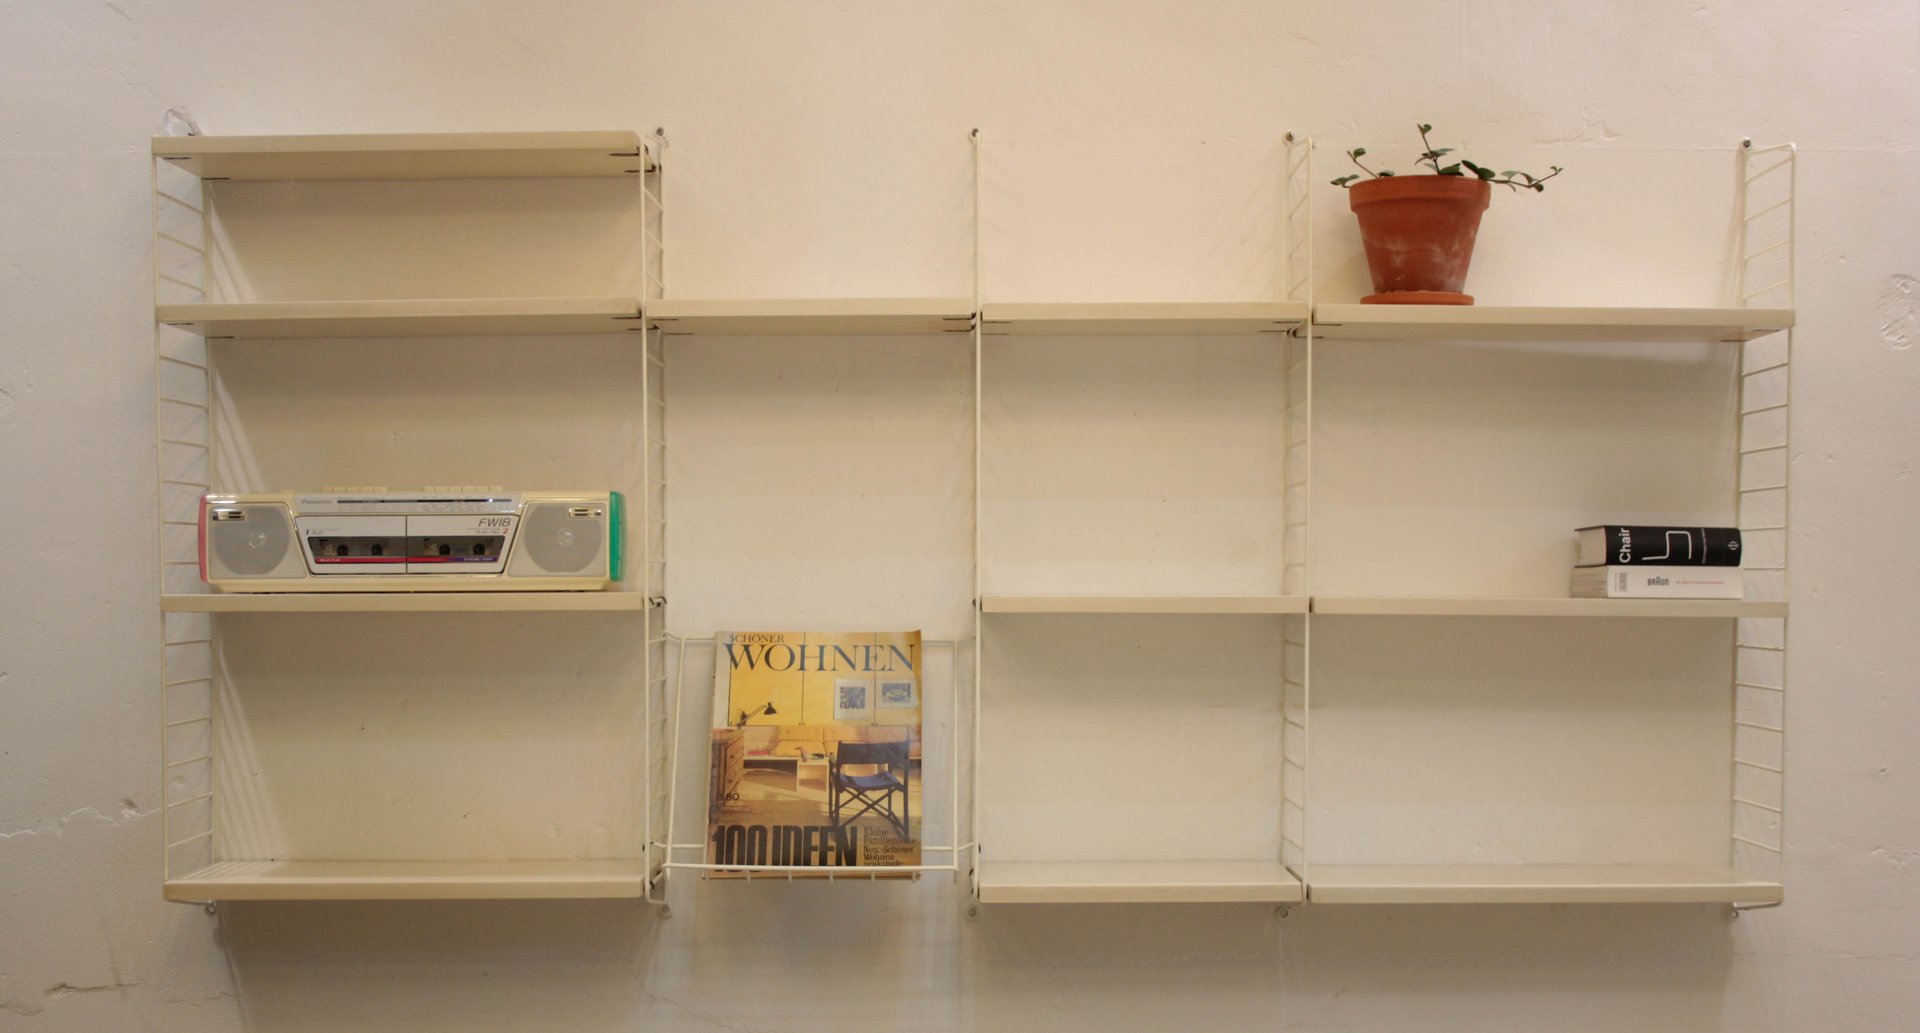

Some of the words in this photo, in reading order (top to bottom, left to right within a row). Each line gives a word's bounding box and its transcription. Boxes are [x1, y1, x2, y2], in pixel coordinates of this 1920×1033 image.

[478, 517, 512, 527] FW18
[1619, 528, 1631, 563] Chair
[729, 632, 785, 643] SCHÖNER
[723, 643, 916, 672] WOHNEN
[713, 824, 768, 872] 100
